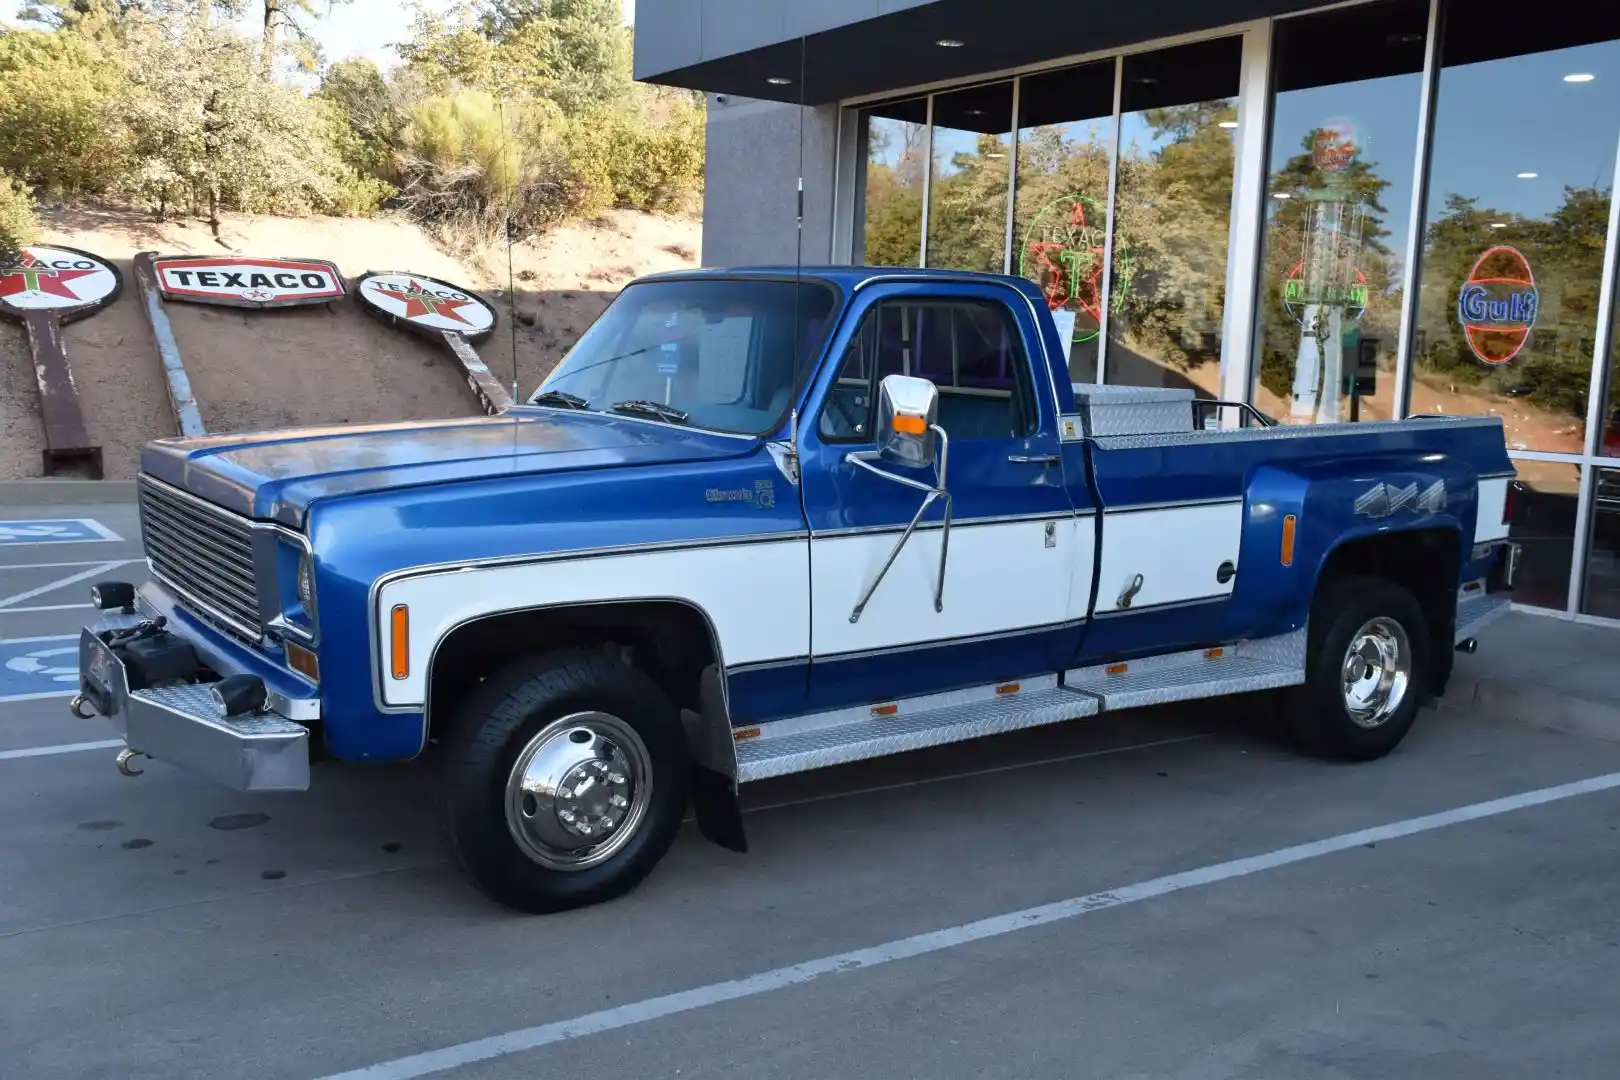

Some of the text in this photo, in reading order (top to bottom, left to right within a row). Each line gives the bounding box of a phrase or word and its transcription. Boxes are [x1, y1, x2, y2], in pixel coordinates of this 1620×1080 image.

[1039, 224, 1106, 248] TEXAC
[12, 259, 96, 270] XACO
[170, 270, 326, 289] TEXACO
[369, 280, 469, 302] TEXACO
[1463, 286, 1537, 322] Gulf
